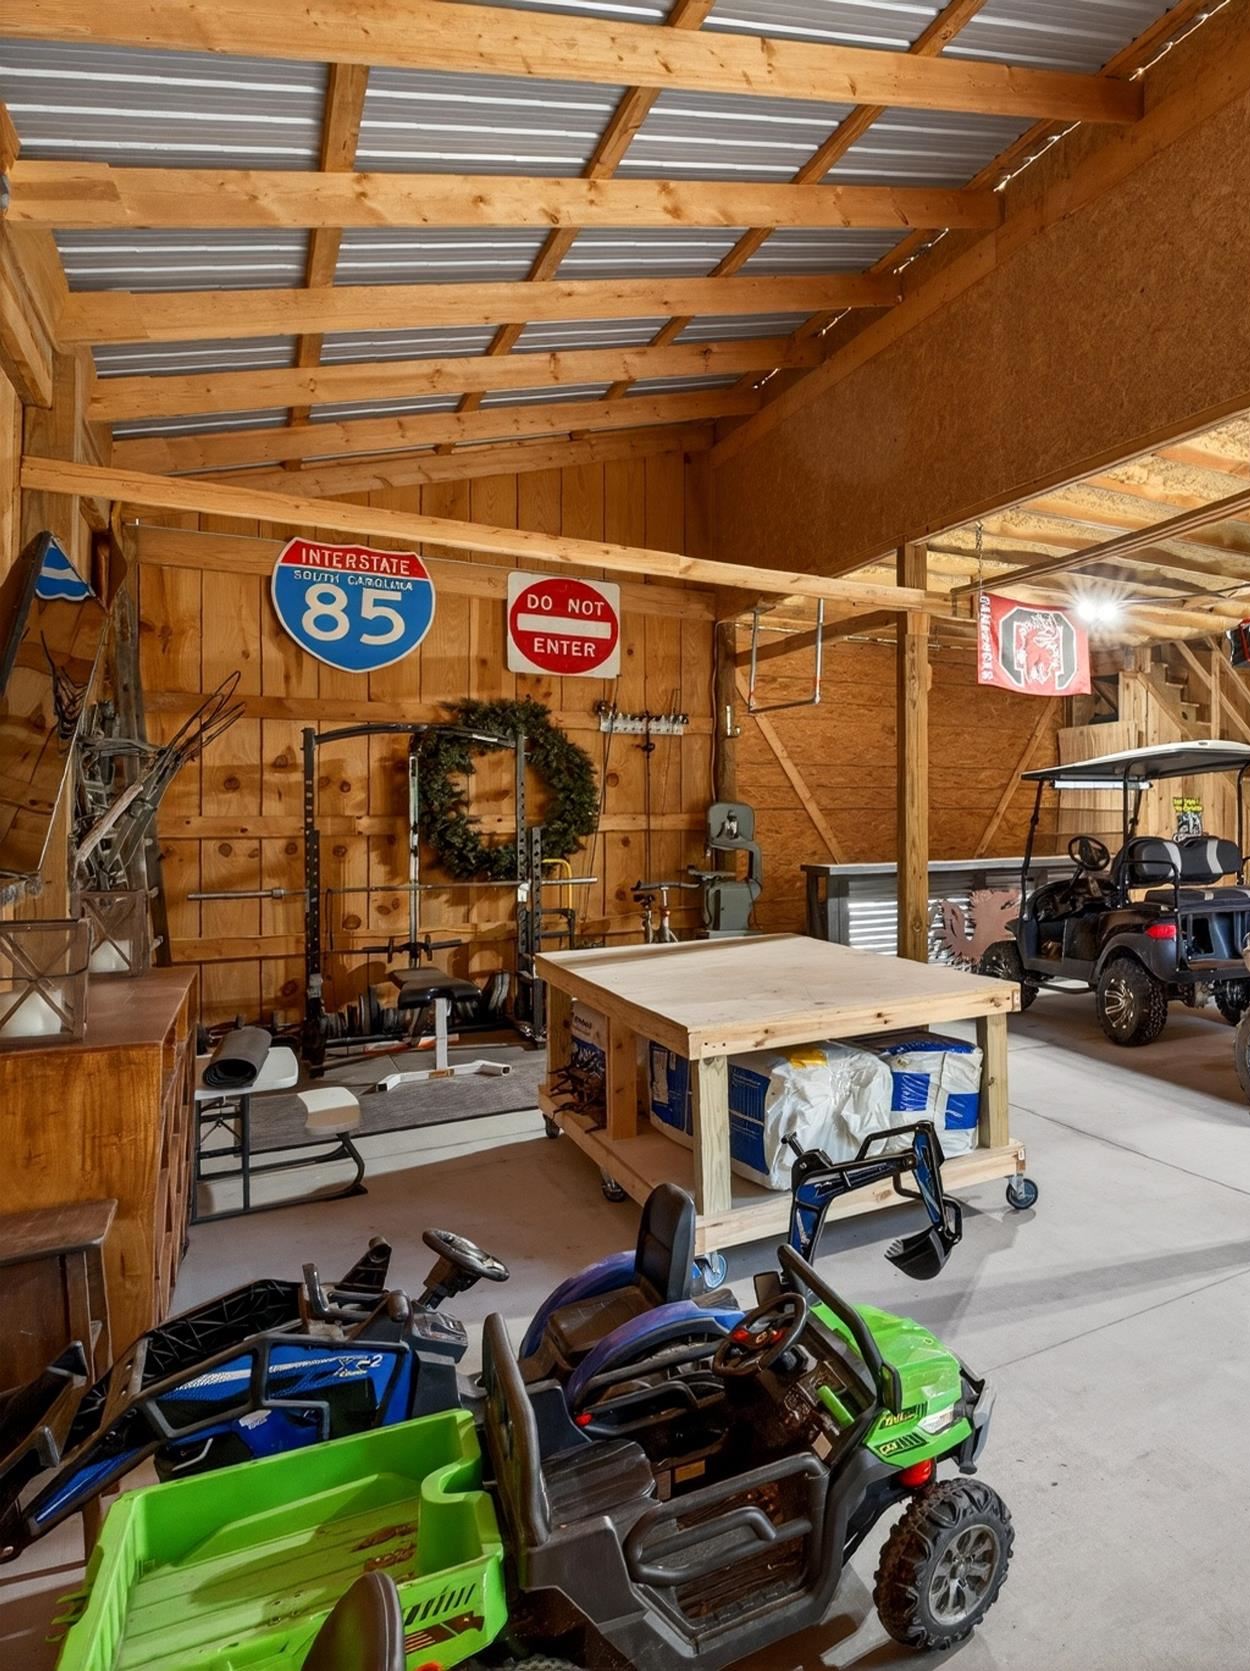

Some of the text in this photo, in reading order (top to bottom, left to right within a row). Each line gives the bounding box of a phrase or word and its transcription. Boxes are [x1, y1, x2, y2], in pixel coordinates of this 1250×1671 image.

[301, 547, 410, 575] INTERSTATE
[293, 570, 414, 592] SOUTH CAROLINA
[301, 582, 406, 646] 85
[527, 593, 605, 616] DO NOT
[533, 637, 596, 658] ENTER
